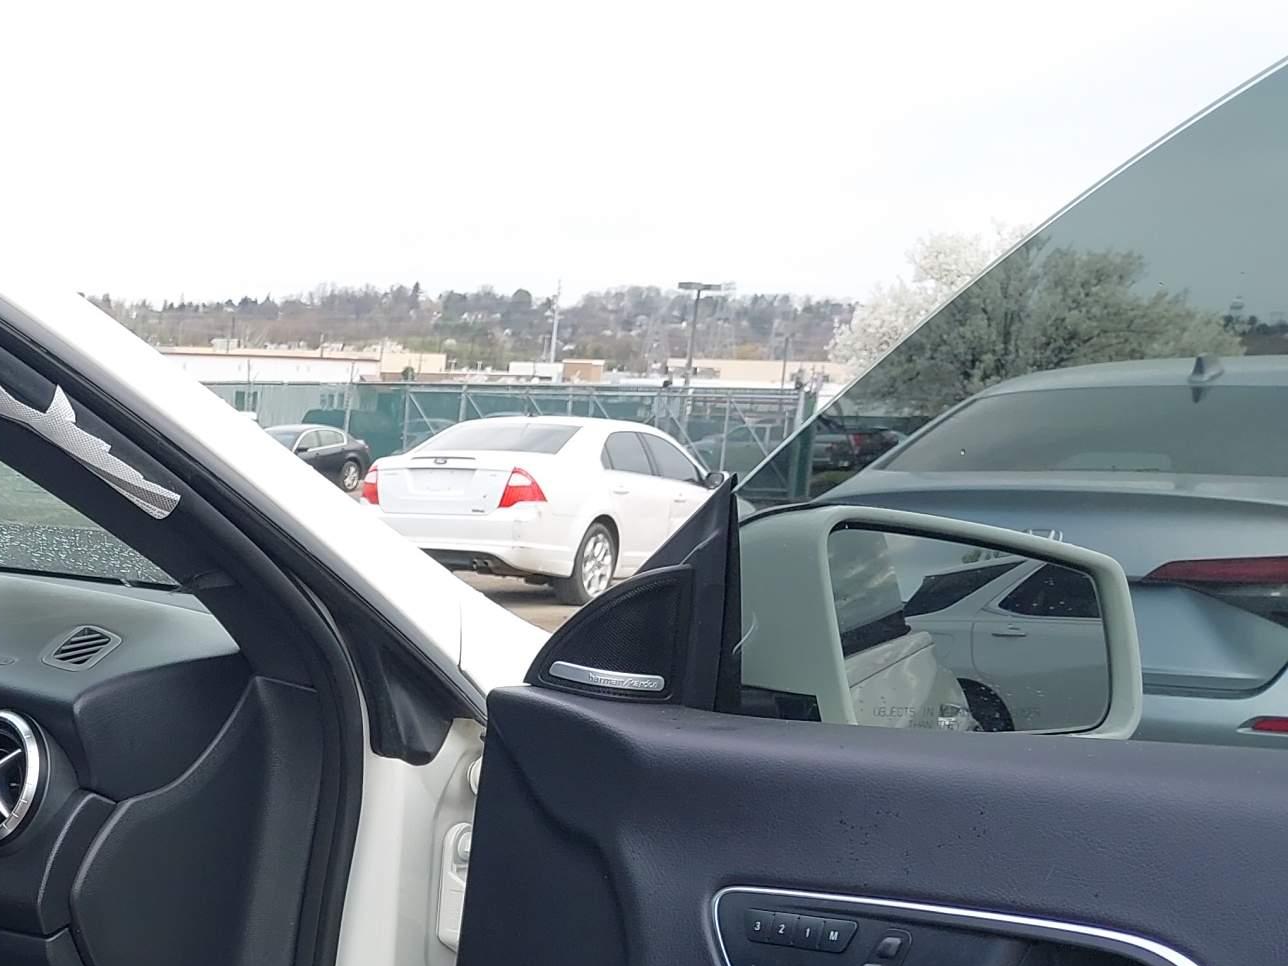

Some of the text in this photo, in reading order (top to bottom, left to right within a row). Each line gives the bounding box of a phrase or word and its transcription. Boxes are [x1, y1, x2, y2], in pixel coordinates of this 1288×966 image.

[872, 706, 915, 717] OBJECTS
[754, 921, 839, 941] 3 2 1 M
